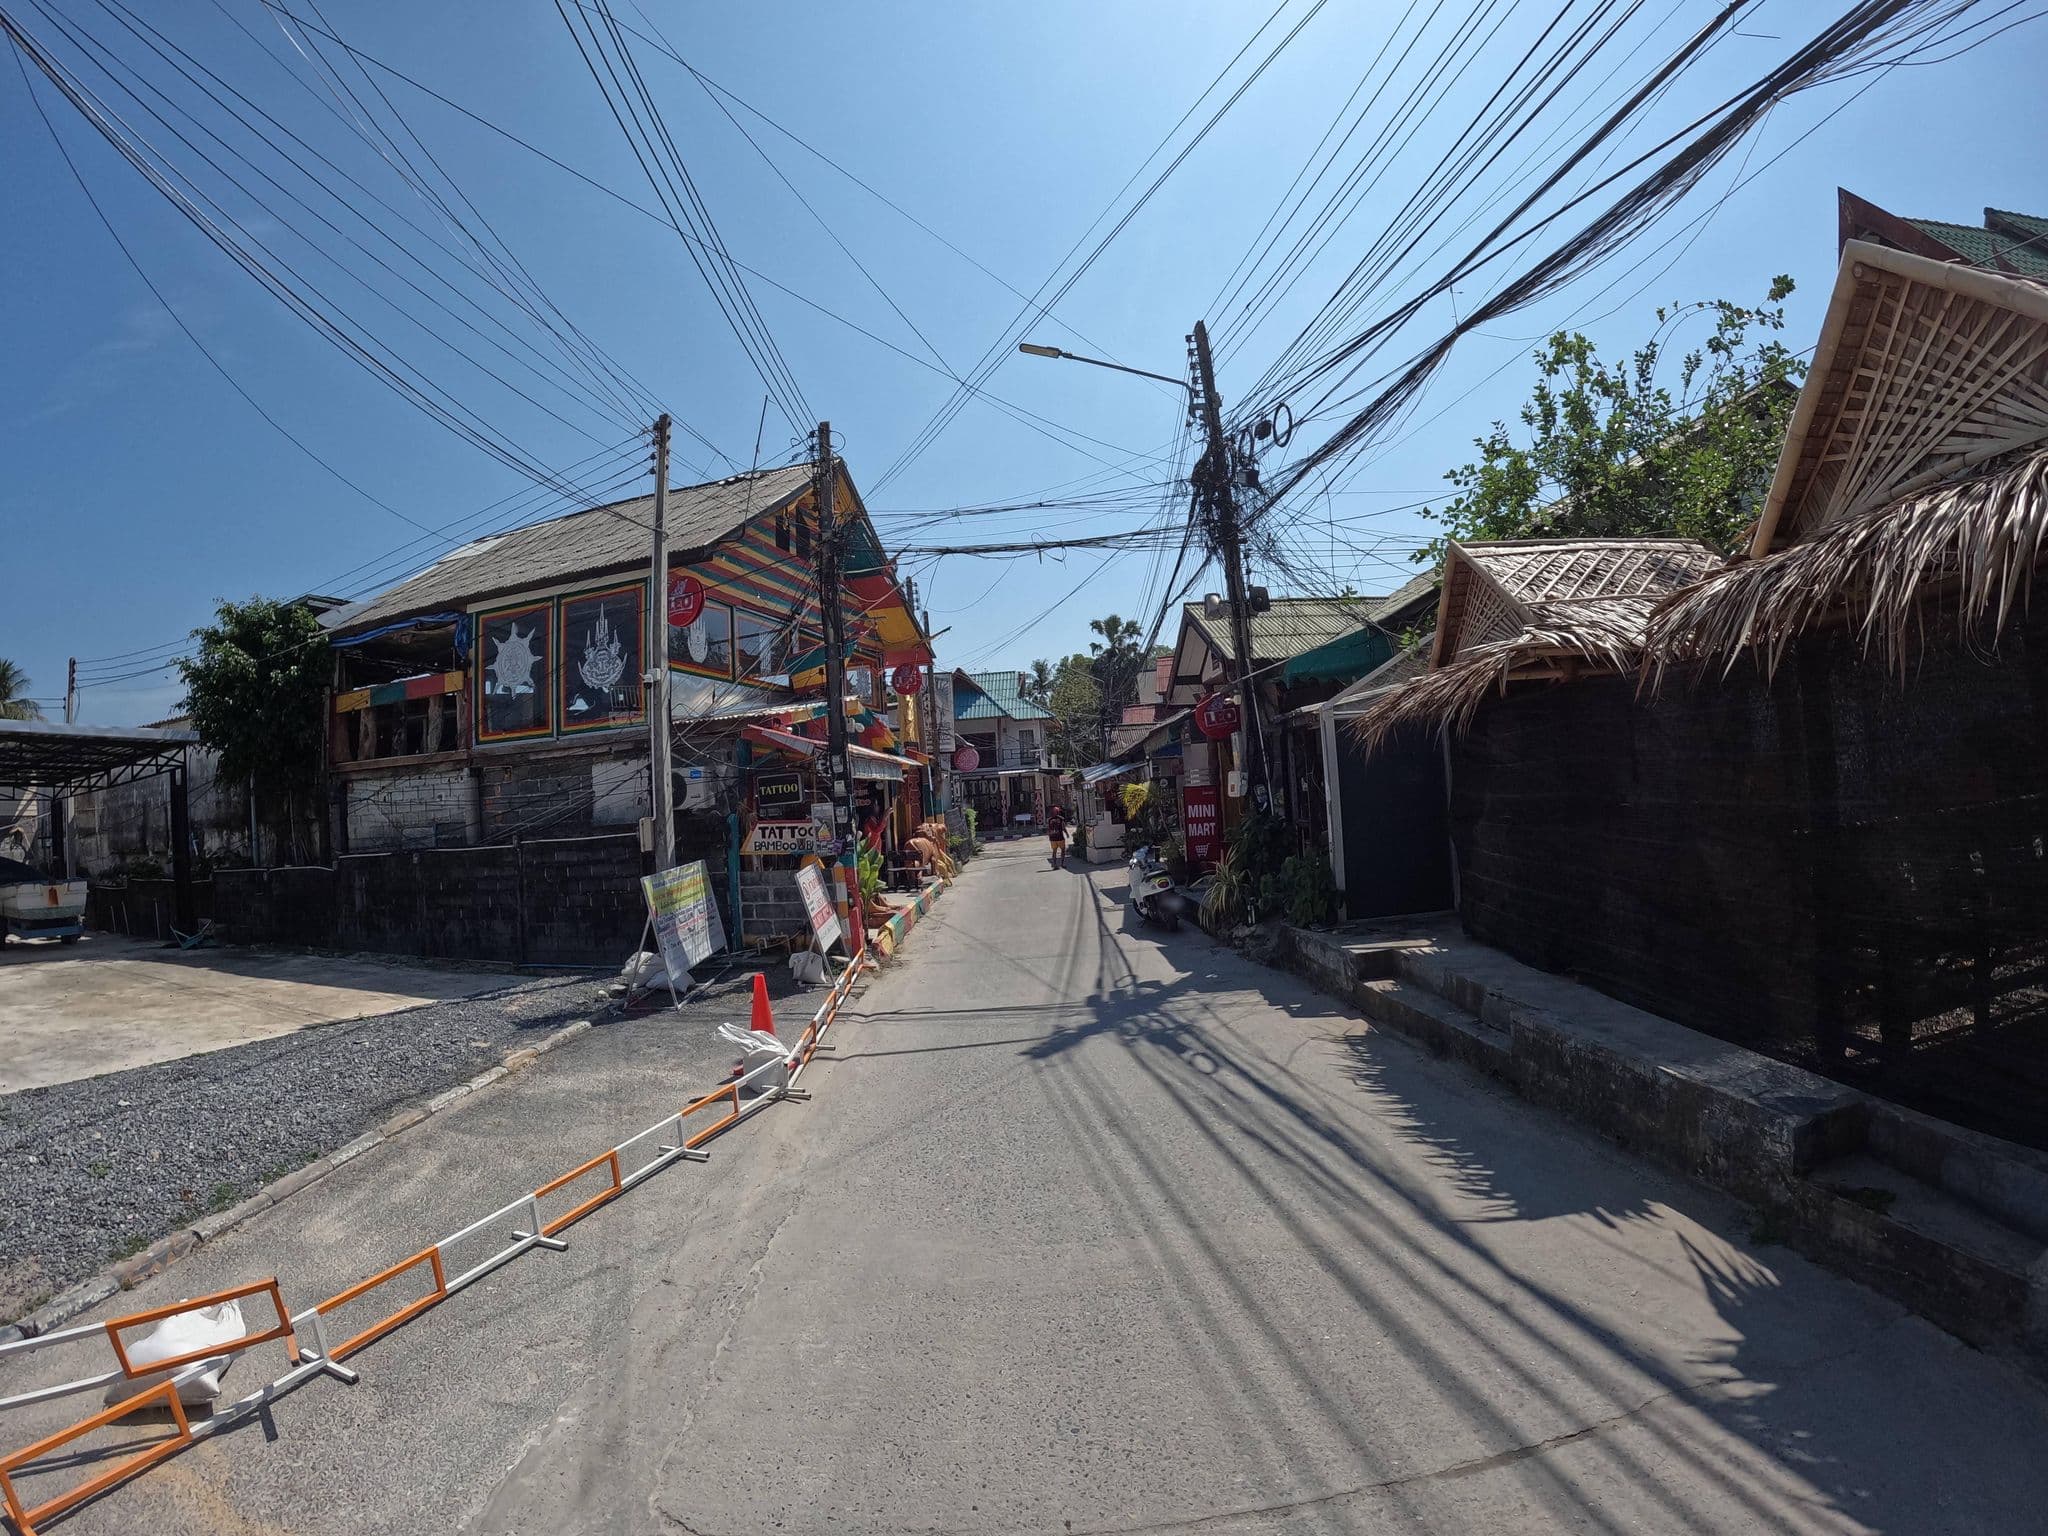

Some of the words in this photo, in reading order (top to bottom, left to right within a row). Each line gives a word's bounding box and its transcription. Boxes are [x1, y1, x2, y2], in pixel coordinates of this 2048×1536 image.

[760, 783, 798, 796] TATTOO
[1187, 804, 1215, 818] MINI
[1188, 822, 1216, 837] MART
